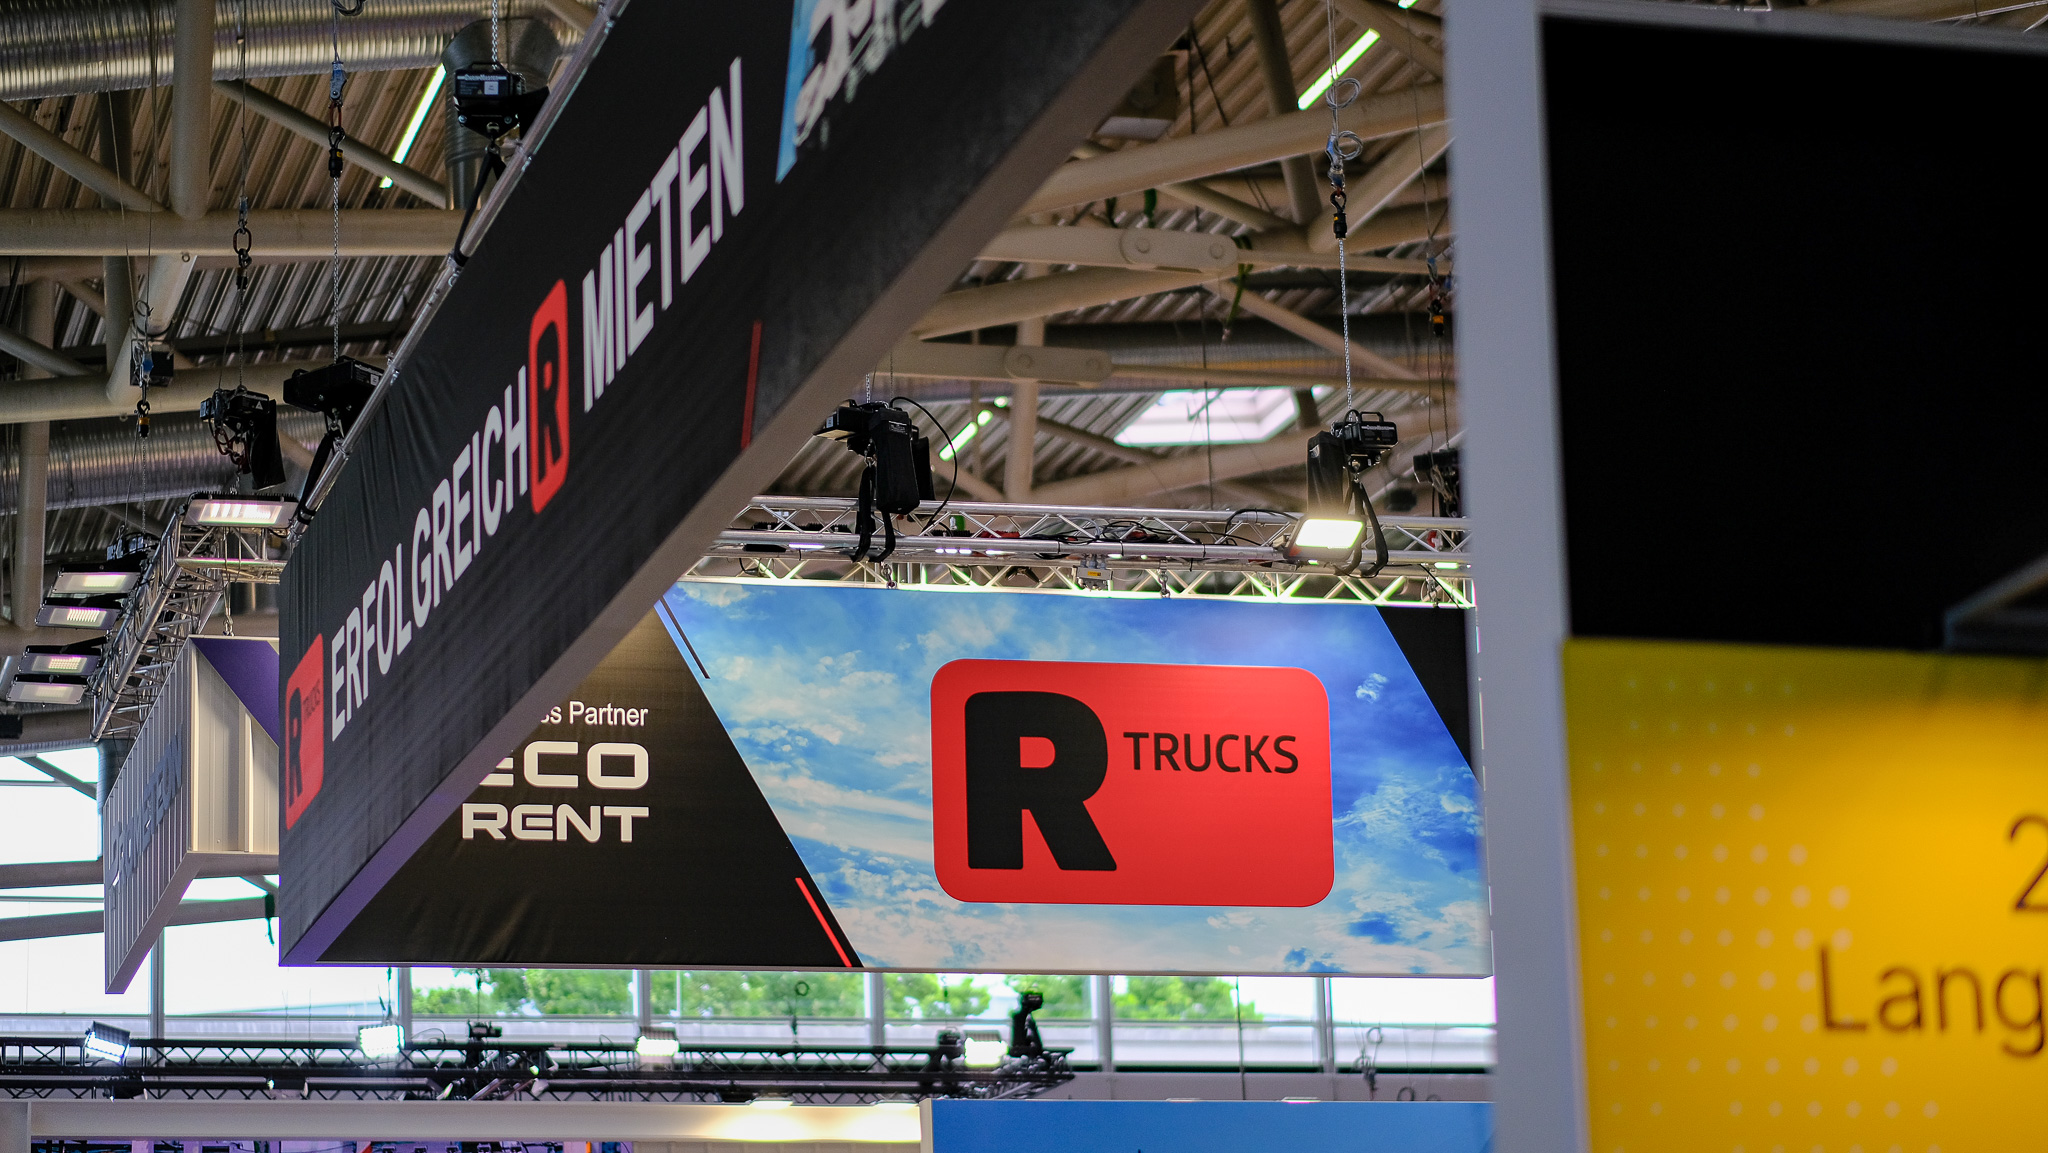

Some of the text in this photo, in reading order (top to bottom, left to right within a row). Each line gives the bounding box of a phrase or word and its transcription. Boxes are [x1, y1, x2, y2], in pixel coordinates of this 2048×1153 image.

[331, 57, 744, 742] ERFOLGREICH R MIETEN
[569, 701, 649, 726] Partner
[462, 803, 649, 843] RENT
[964, 691, 1299, 871] R TRUCKS
[1818, 943, 2046, 1060] Lang
